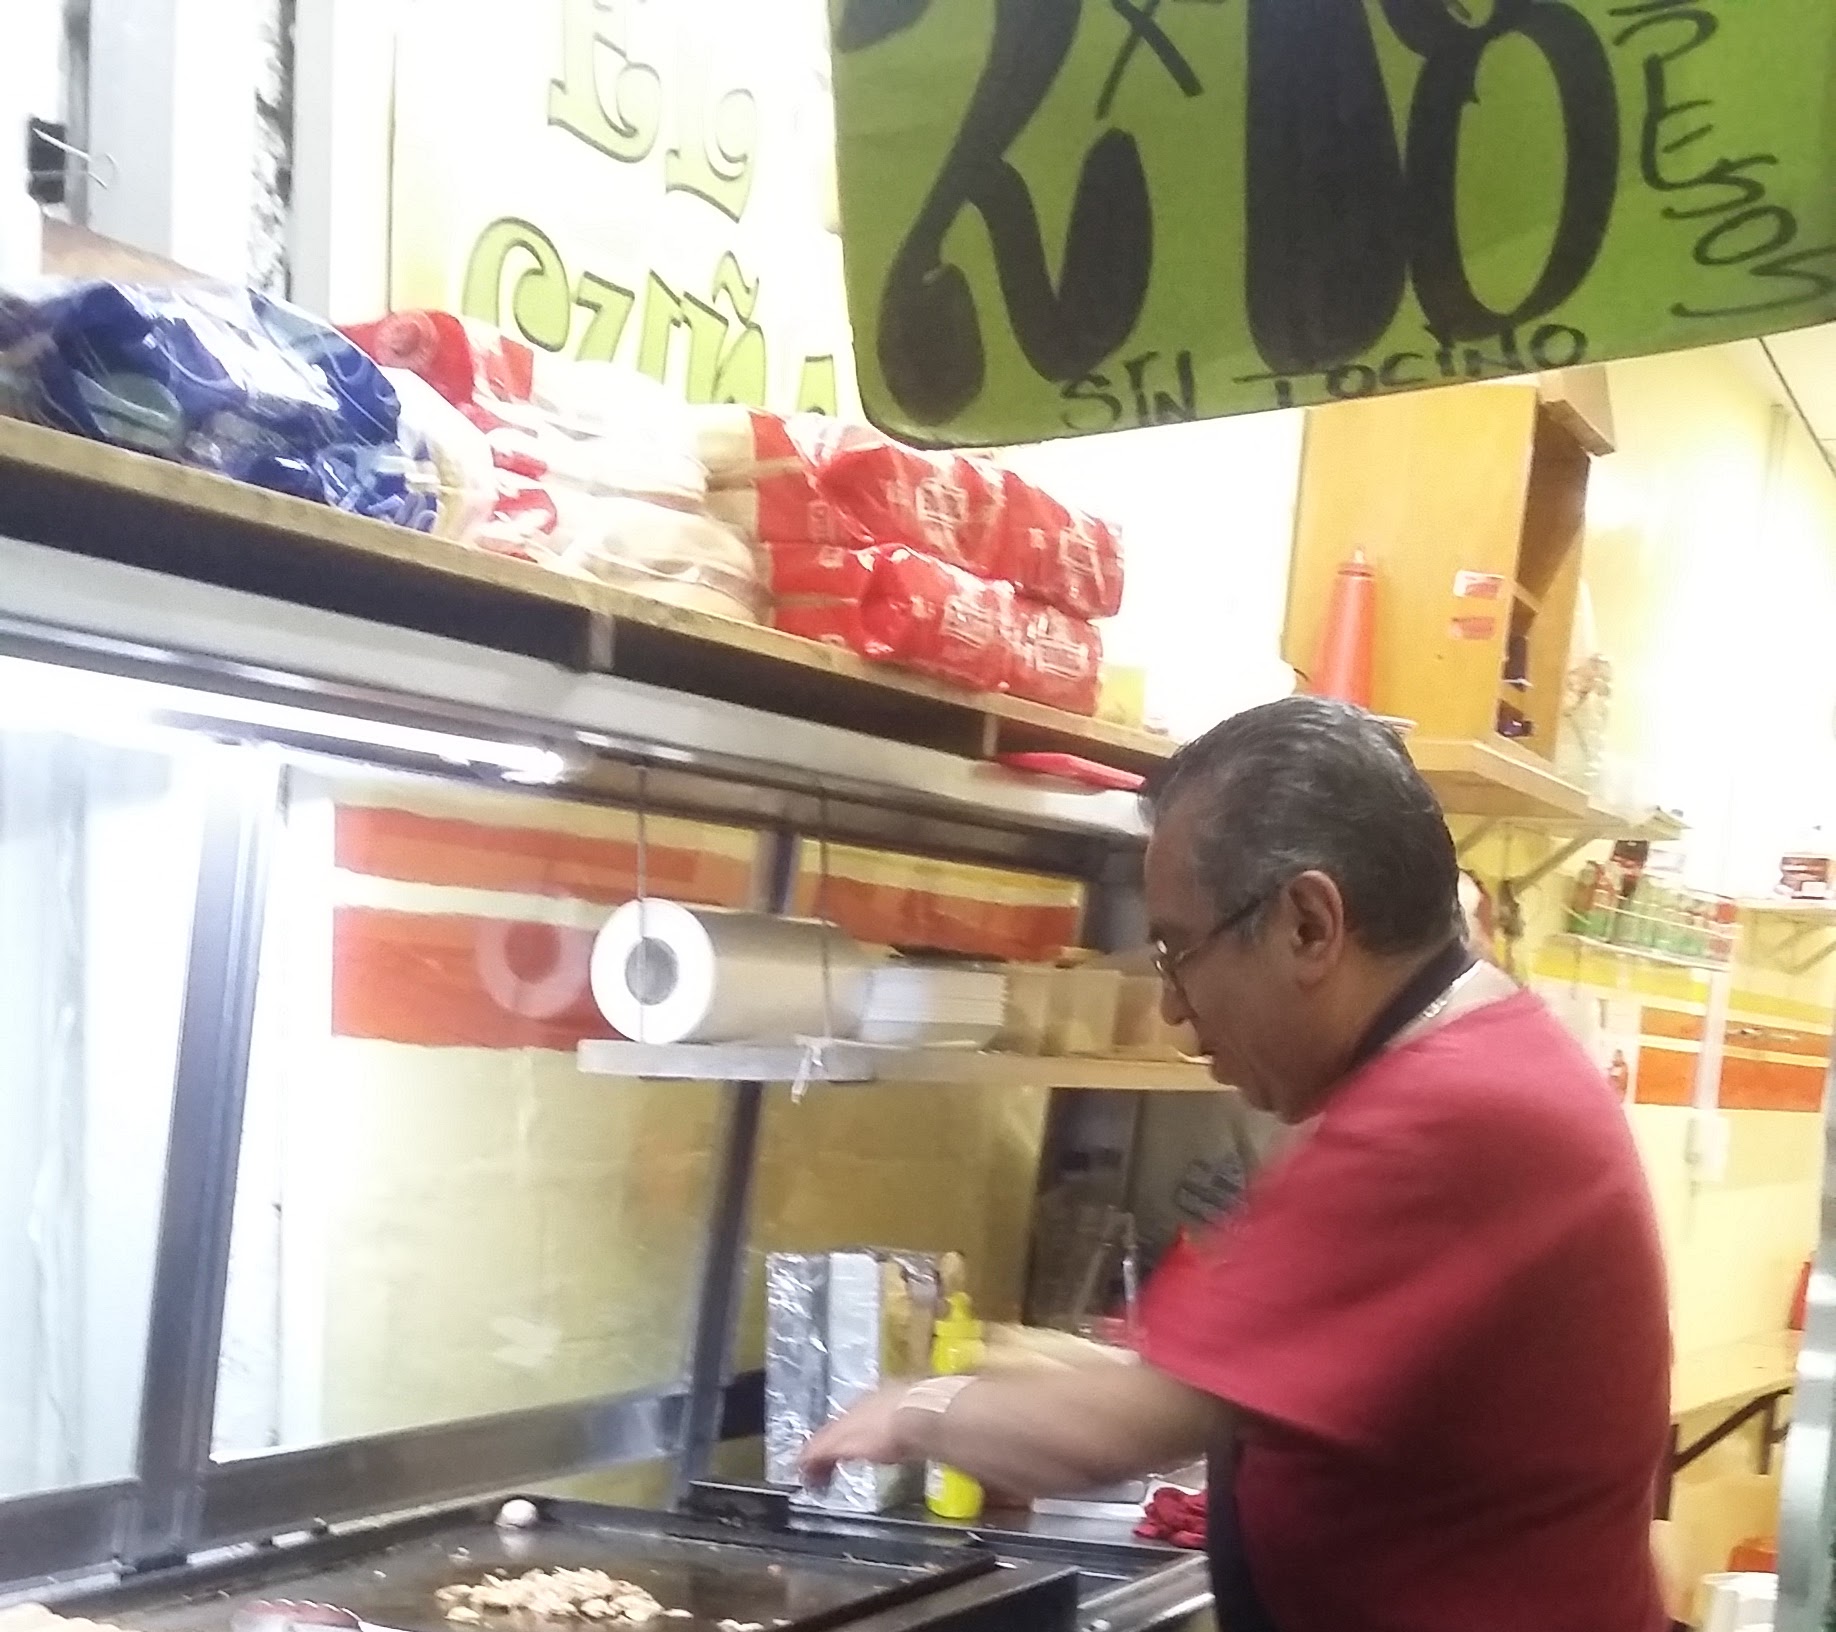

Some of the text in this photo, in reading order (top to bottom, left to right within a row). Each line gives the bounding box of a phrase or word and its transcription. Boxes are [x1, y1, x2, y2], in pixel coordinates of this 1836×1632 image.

[1609, 6, 1836, 318] PESOS
[1061, 323, 1588, 430] SIN TOCINO
